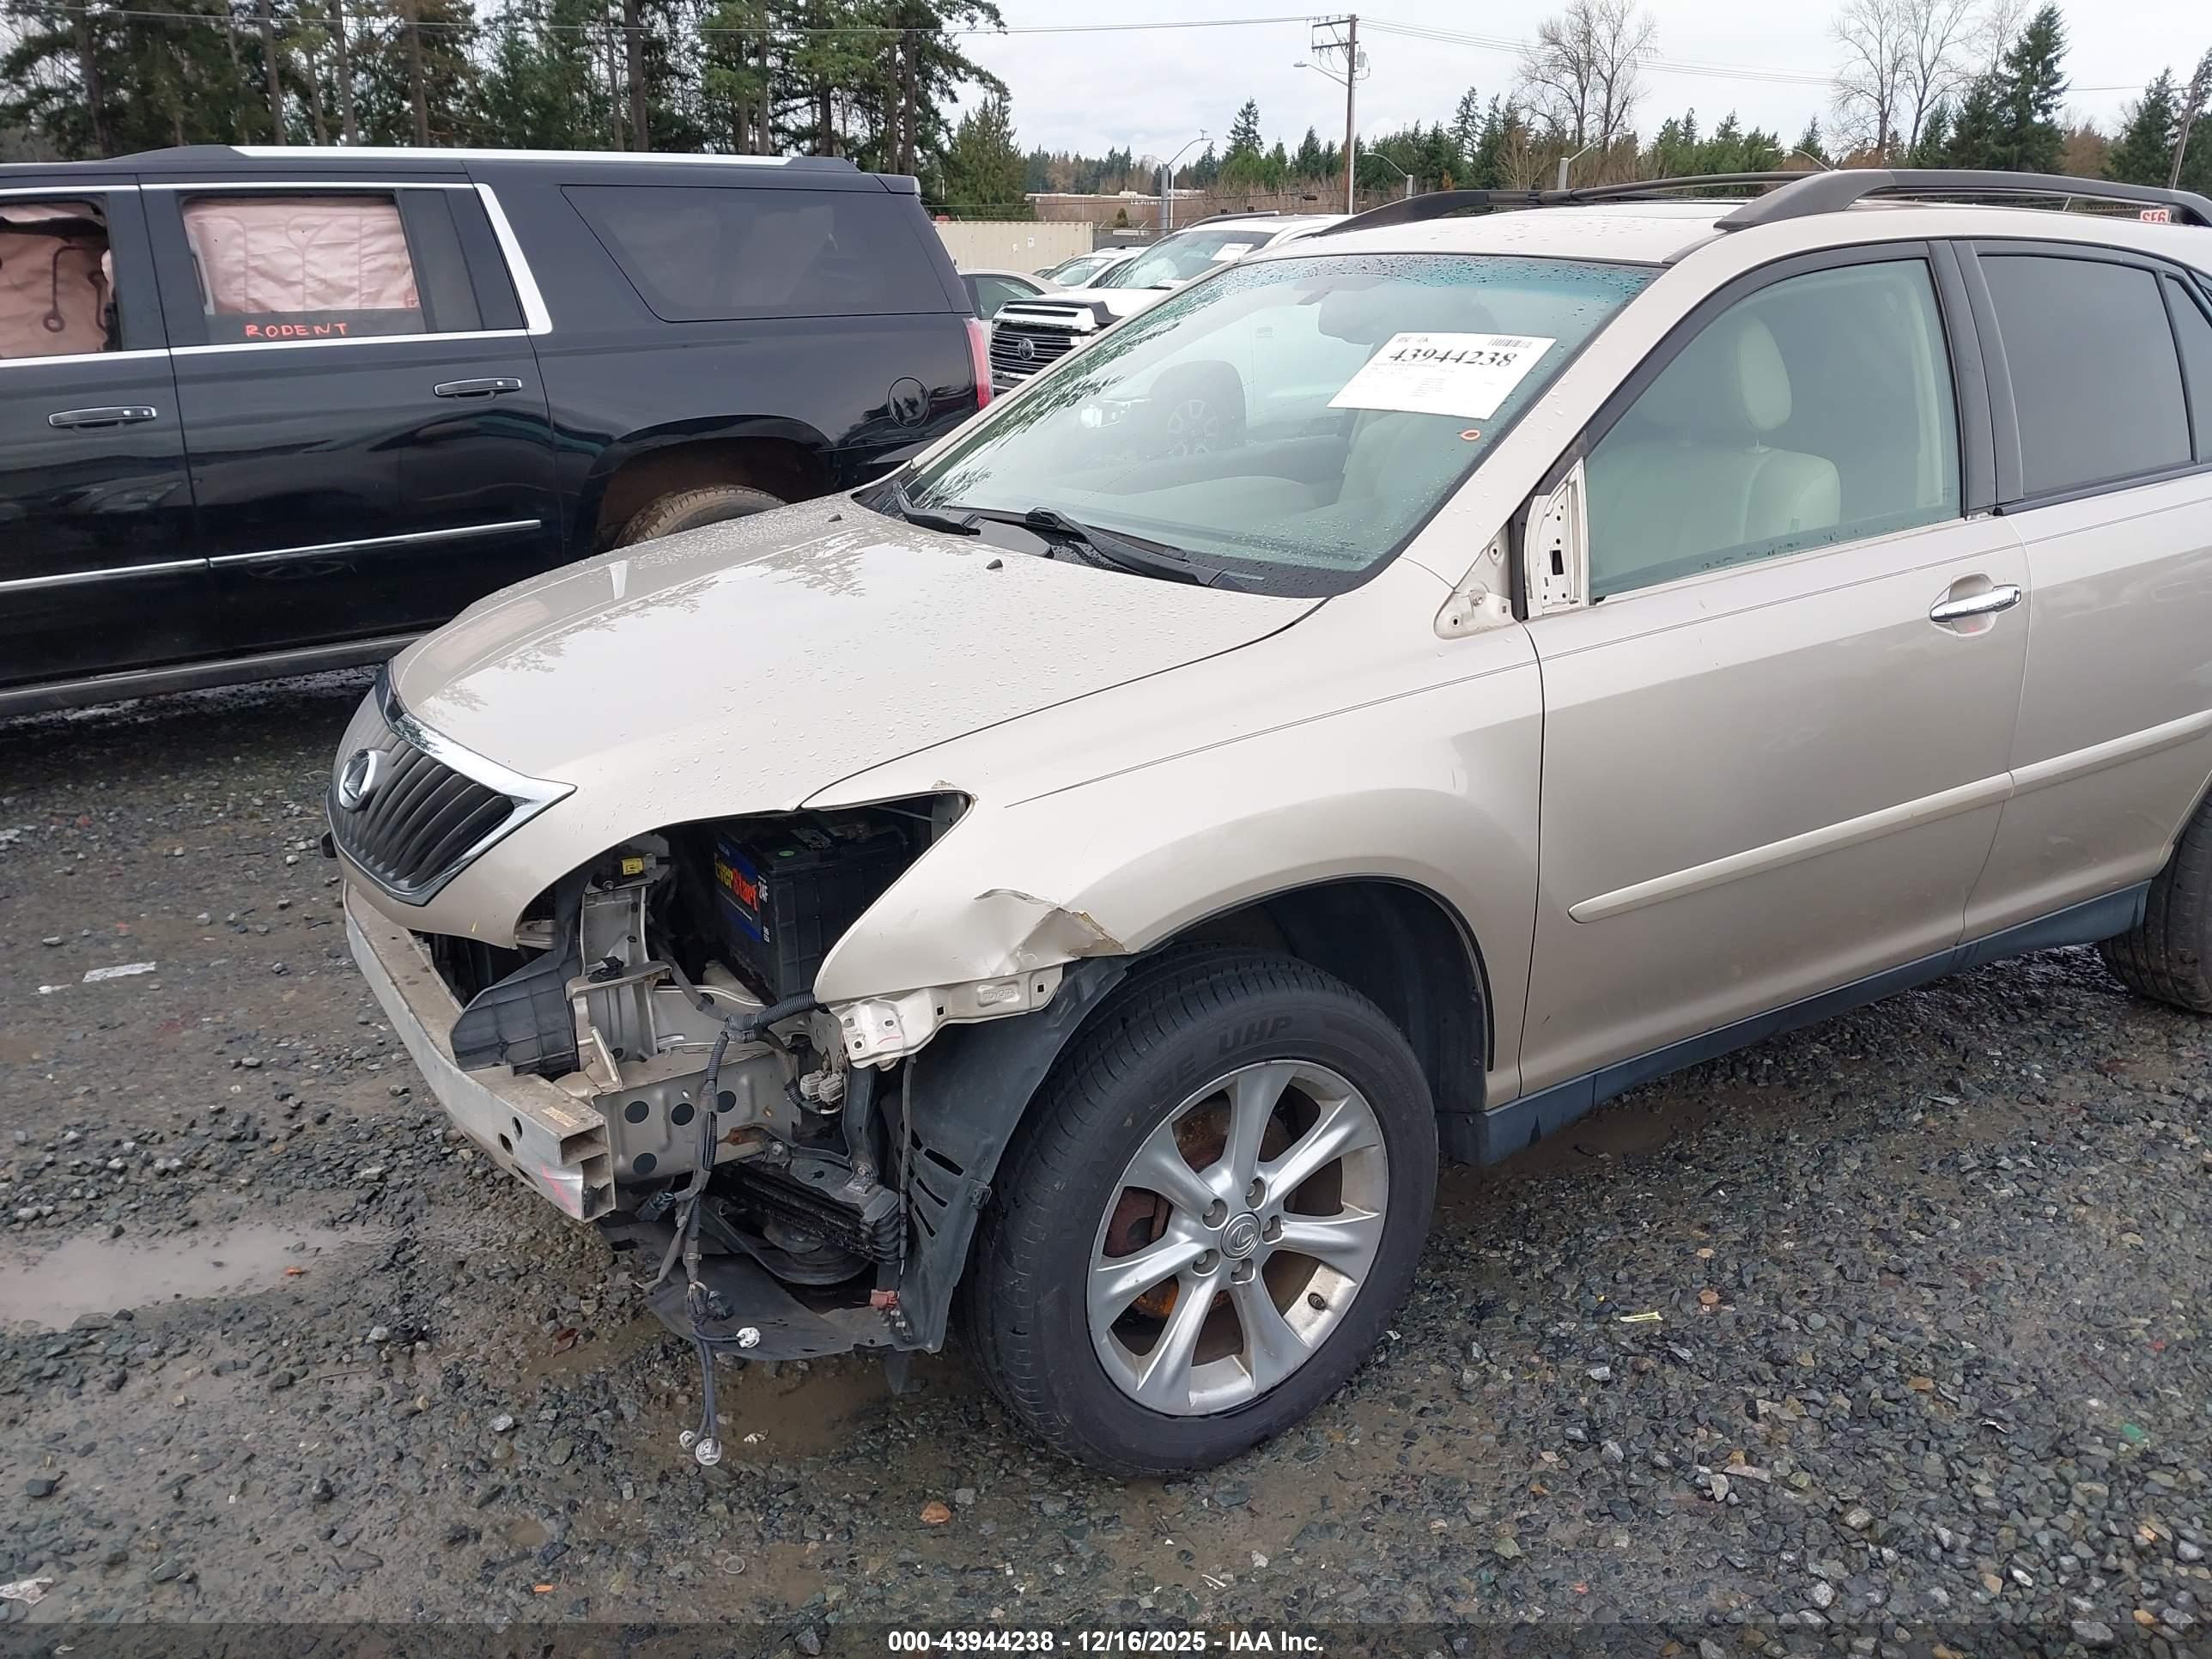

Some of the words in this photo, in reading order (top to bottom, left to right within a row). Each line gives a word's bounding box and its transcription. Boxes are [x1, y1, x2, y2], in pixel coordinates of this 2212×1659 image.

[246, 323, 347, 337] RODENT
[1389, 348, 1517, 367] 43944238
[1218, 1015, 1293, 1054] UHP
